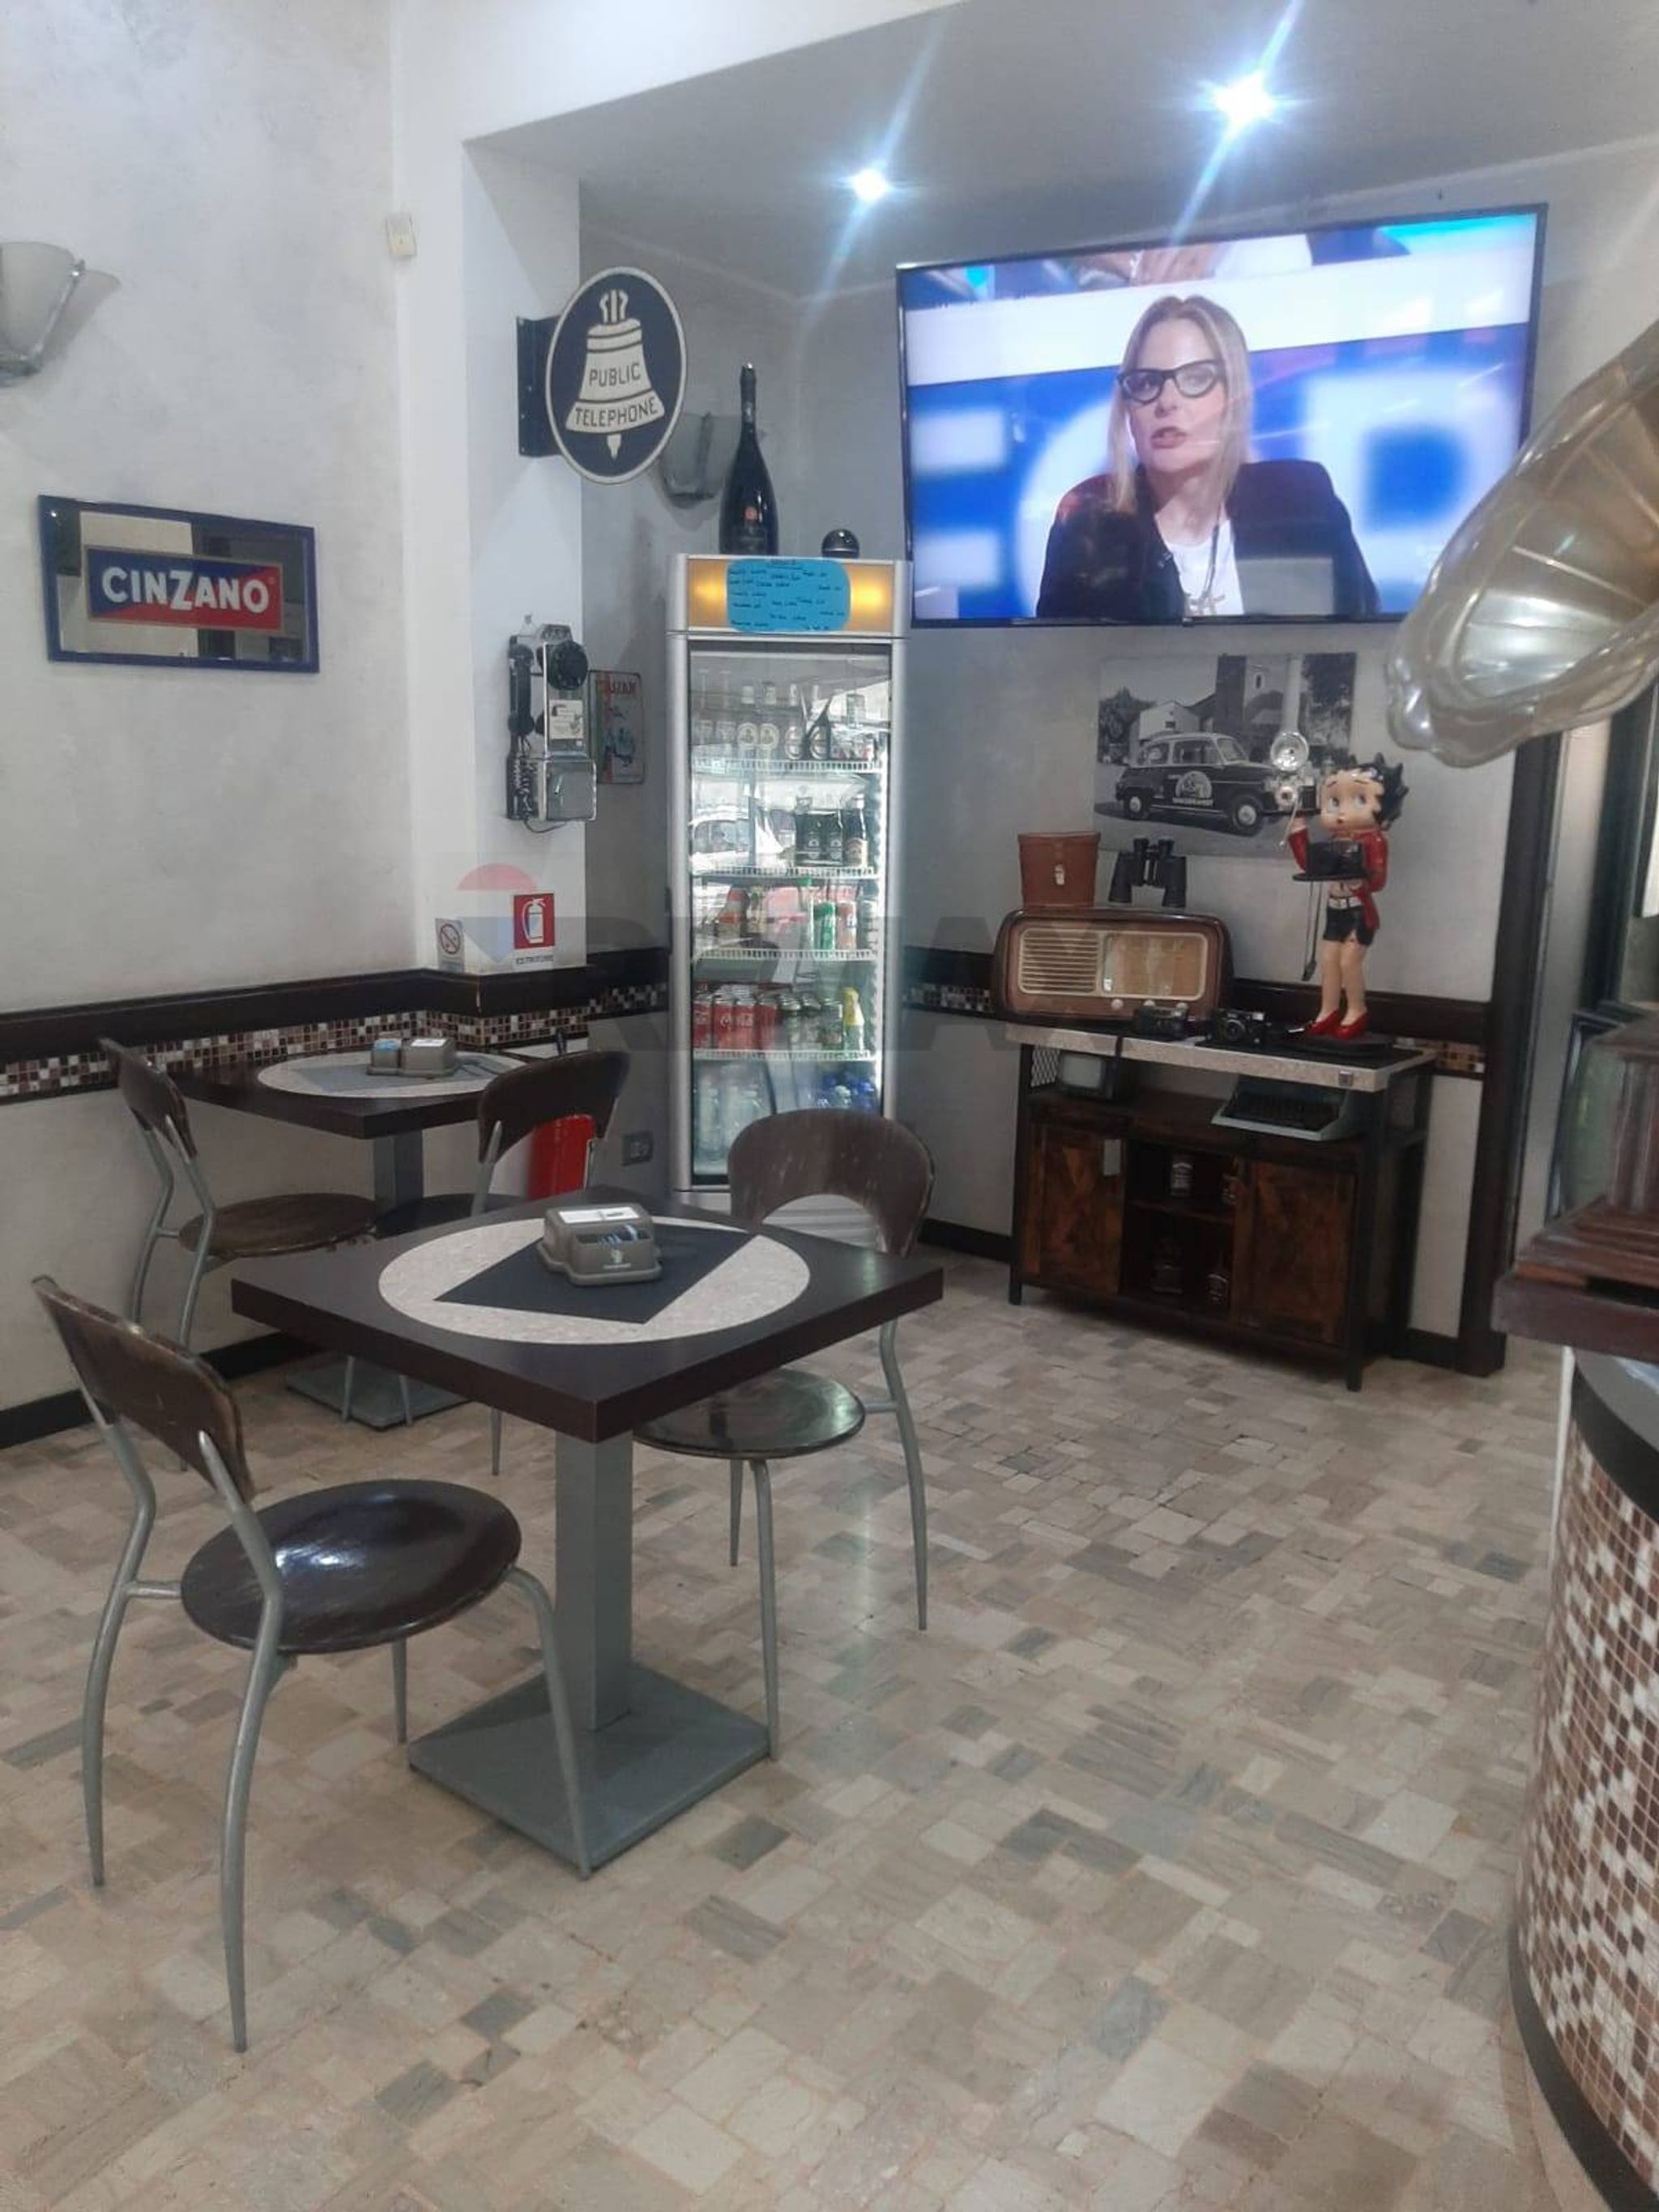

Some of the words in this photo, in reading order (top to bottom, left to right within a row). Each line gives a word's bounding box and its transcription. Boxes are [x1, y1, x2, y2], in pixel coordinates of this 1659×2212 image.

[589, 363, 641, 388] PUBLIC
[574, 396, 658, 427] TELEPHONE
[101, 566, 269, 613] CINZANO
